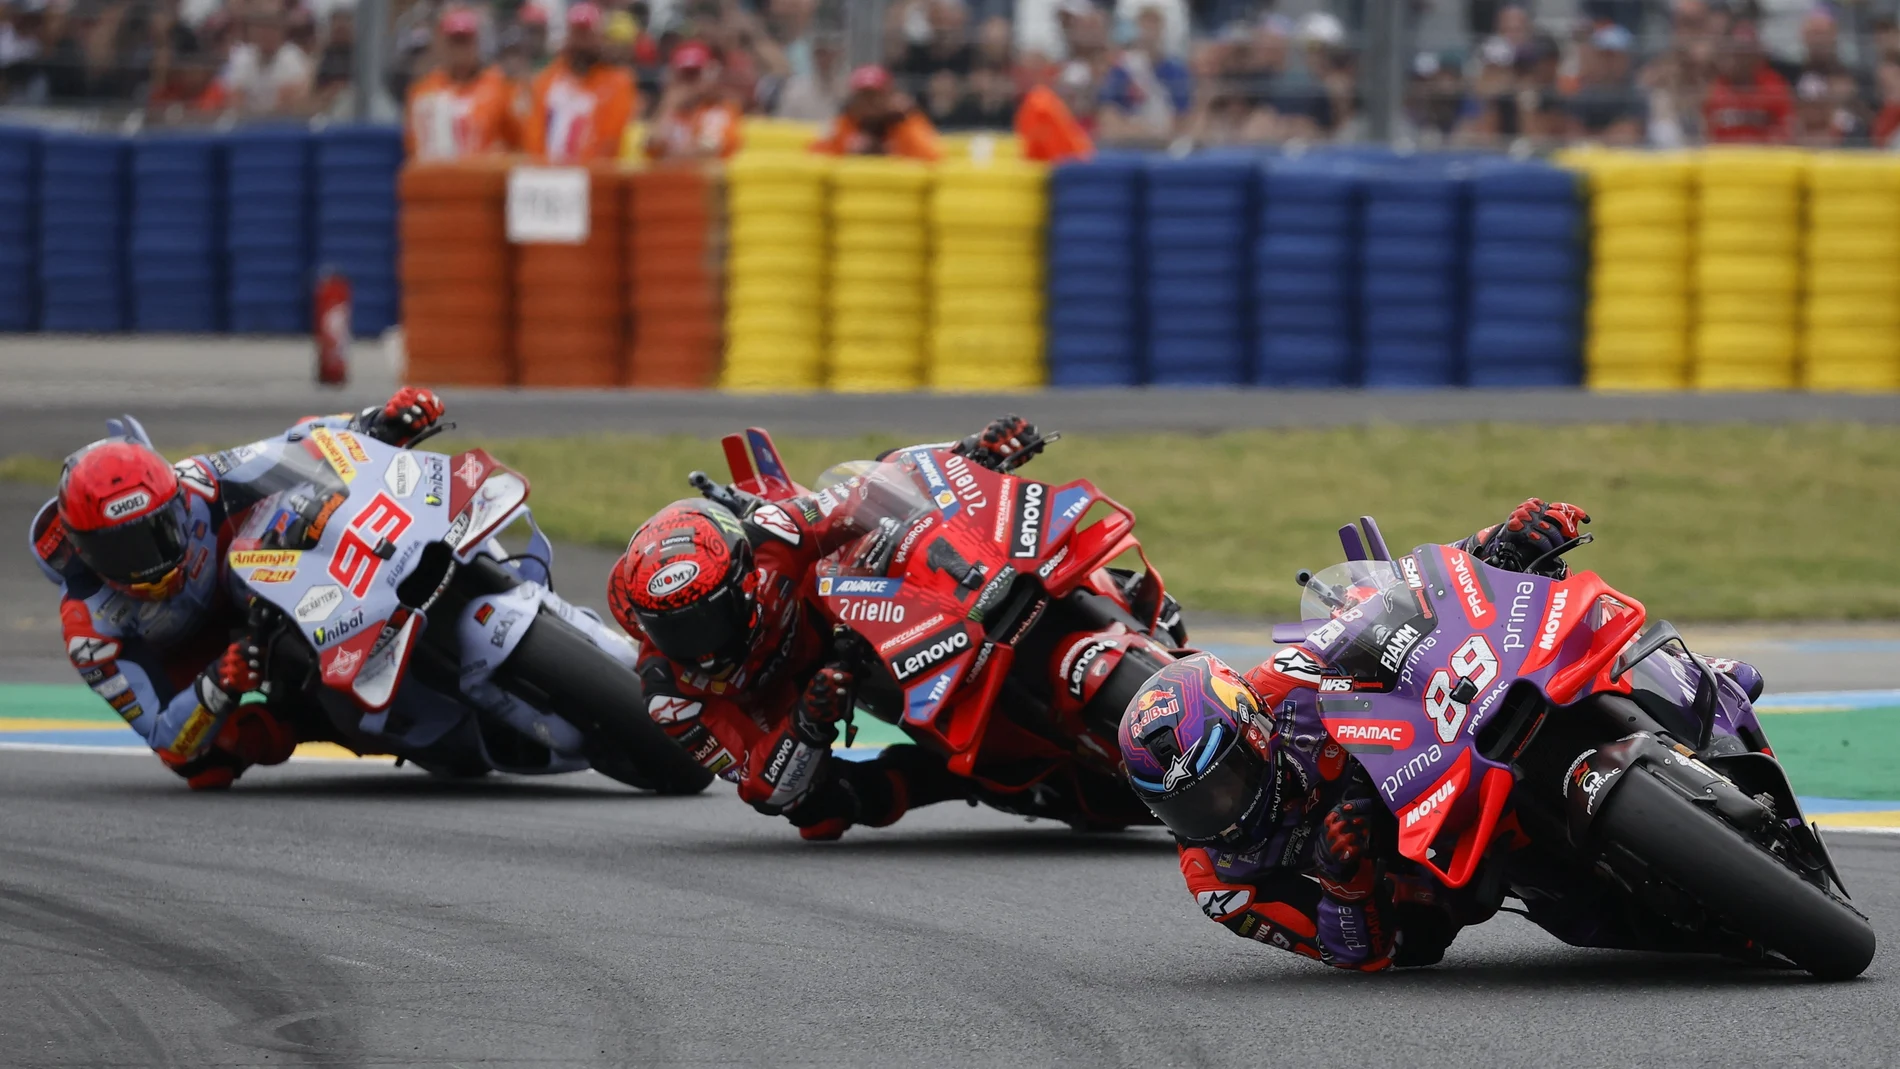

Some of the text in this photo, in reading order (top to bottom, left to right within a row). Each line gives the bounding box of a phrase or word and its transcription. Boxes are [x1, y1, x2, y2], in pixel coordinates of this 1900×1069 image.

[914, 452, 944, 489] ADVANCE
[110, 493, 145, 516] SHOEI
[995, 478, 1011, 542] FRECCIAROSSA
[1015, 483, 1043, 558] Lenovo
[1062, 495, 1089, 521] TIM
[235, 551, 295, 566] Antangin
[328, 490, 414, 598] 93
[662, 536, 690, 546] Lenovo
[649, 568, 693, 590] SUOMY
[836, 580, 888, 593] ADVANCE
[977, 565, 1014, 611] MONSTER
[1402, 557, 1422, 588] WRS
[1451, 553, 1486, 618] PRAMAC
[313, 611, 363, 646] Unibat
[880, 614, 944, 651] FRECCIAROSSA
[1503, 581, 1534, 652] prima
[1539, 588, 1569, 650] MOTUL
[892, 632, 968, 680] Lenovo
[1070, 639, 1119, 696] Lenovo
[1380, 623, 1419, 671] FIAMM
[1401, 636, 1437, 685] prima
[929, 674, 950, 706] TIM
[1321, 678, 1353, 691] WRS
[1424, 634, 1500, 742] 89
[1150, 699, 1180, 720] Bull
[1467, 681, 1509, 736] PRAMAC
[1337, 725, 1402, 741] PRAMAC
[765, 738, 793, 783] Lenovo
[1381, 744, 1442, 801] prima
[1182, 781, 1196, 791] YOU
[1406, 780, 1456, 828] MOTUL
[1587, 767, 1621, 815] PRAMAC
[1338, 906, 1366, 951] prima
